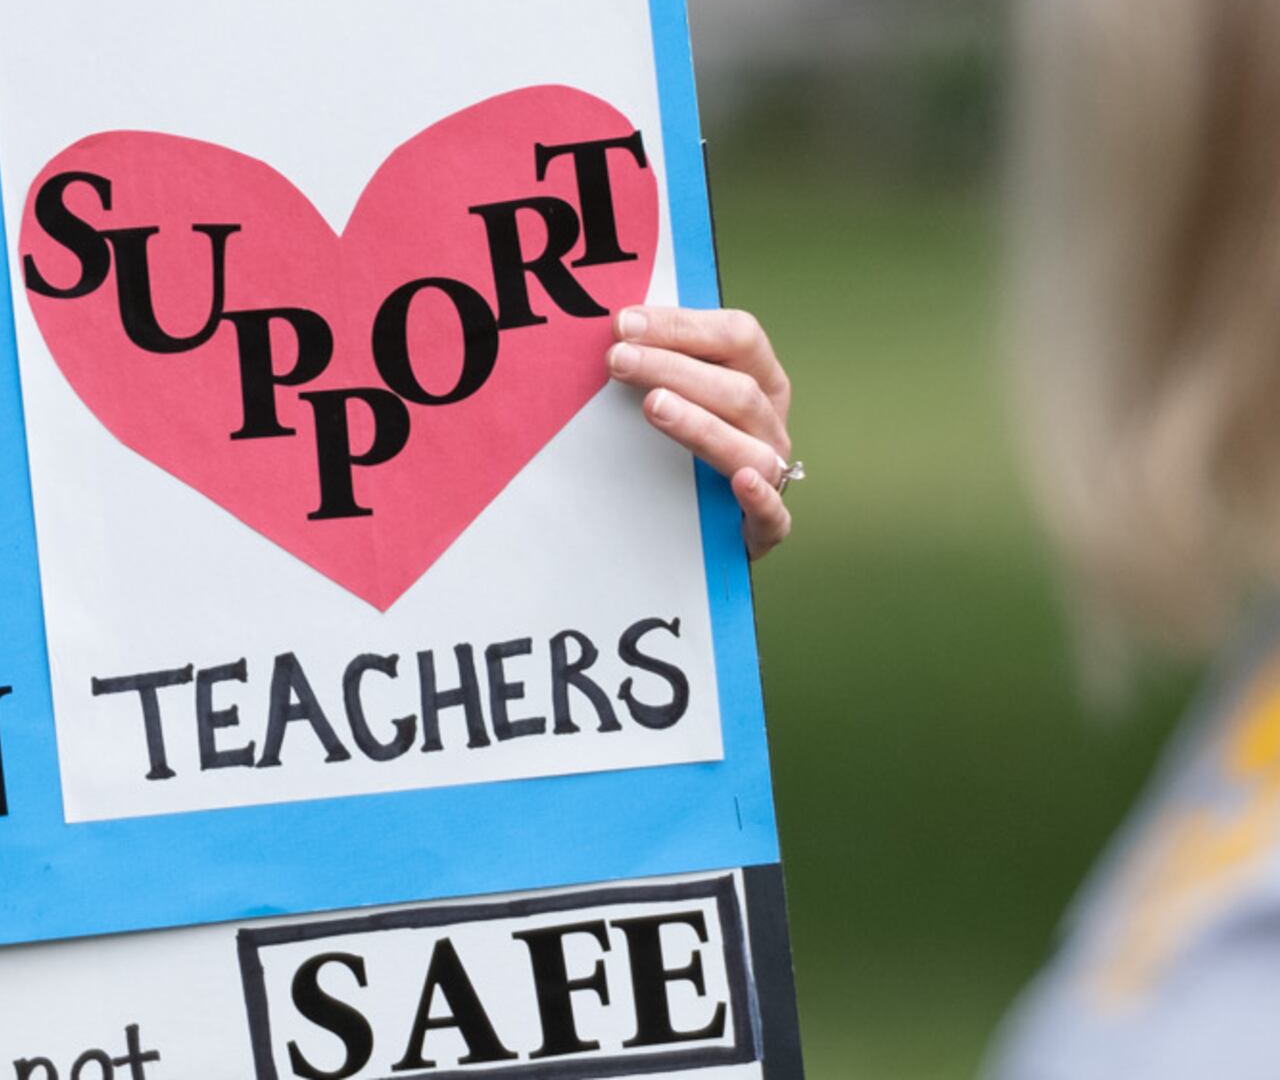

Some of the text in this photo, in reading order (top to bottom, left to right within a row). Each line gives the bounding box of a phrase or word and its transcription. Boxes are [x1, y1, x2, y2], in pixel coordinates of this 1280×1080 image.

[22, 129, 648, 522] SUPPORT
[91, 617, 690, 780] TEACHERS
[286, 910, 727, 1080] SAFE
